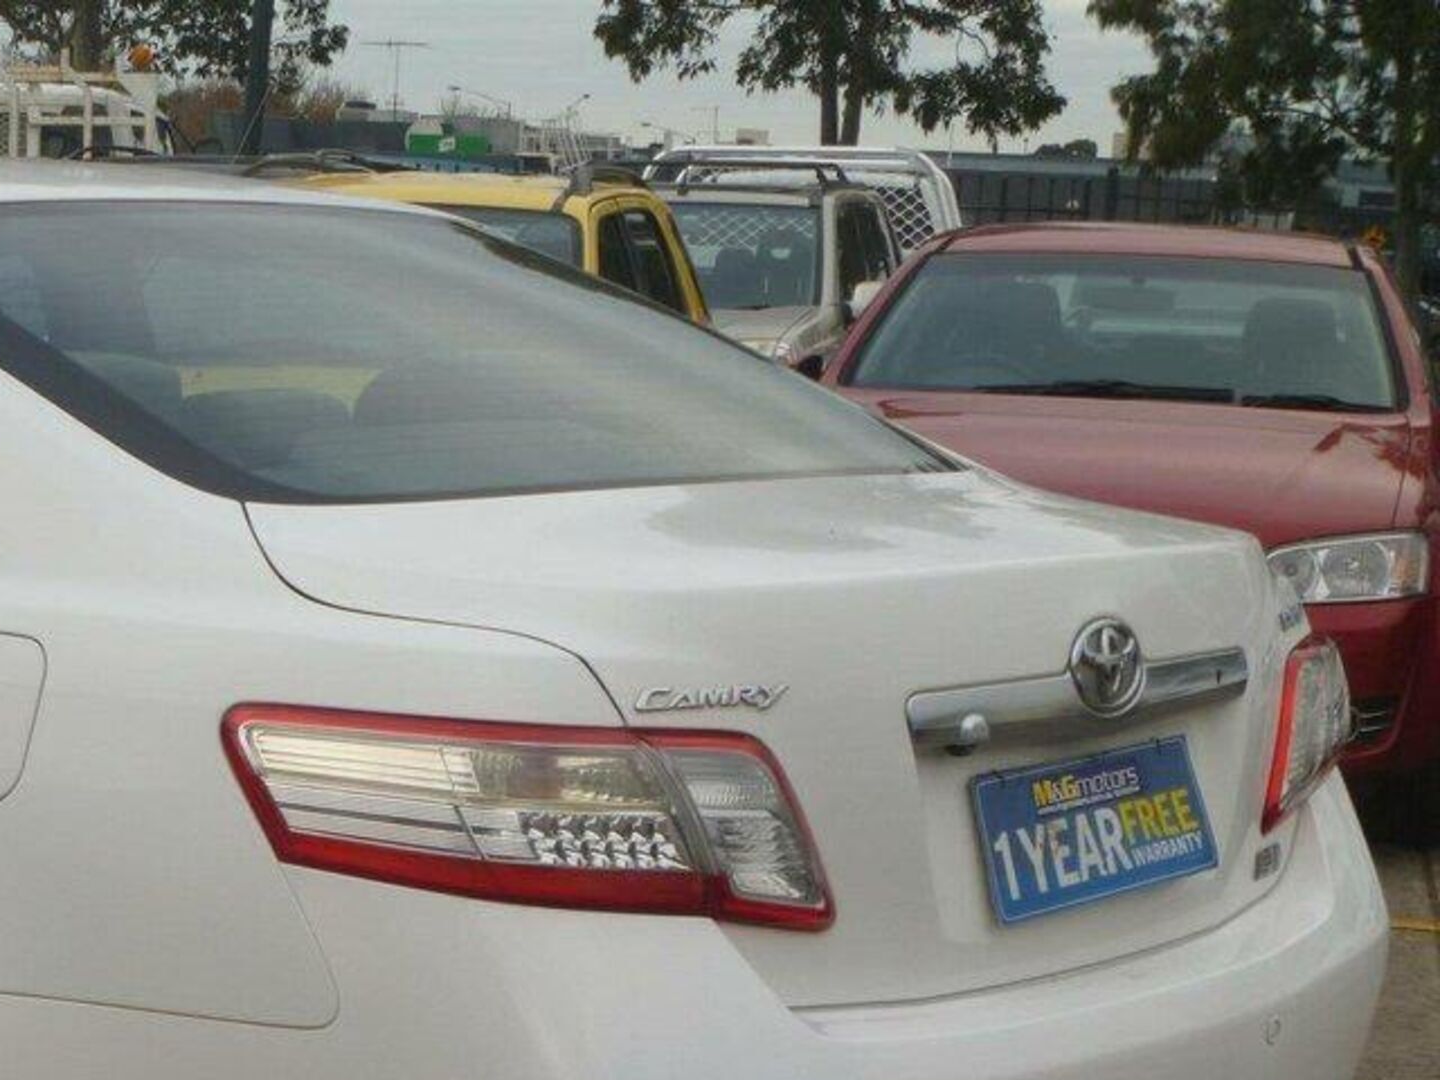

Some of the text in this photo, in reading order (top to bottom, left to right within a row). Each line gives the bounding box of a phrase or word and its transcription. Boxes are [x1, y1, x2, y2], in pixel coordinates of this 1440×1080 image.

[635, 683, 790, 712] CAMRY
[1117, 788, 1199, 845] FREE
[1132, 830, 1204, 867] WARRANTY
